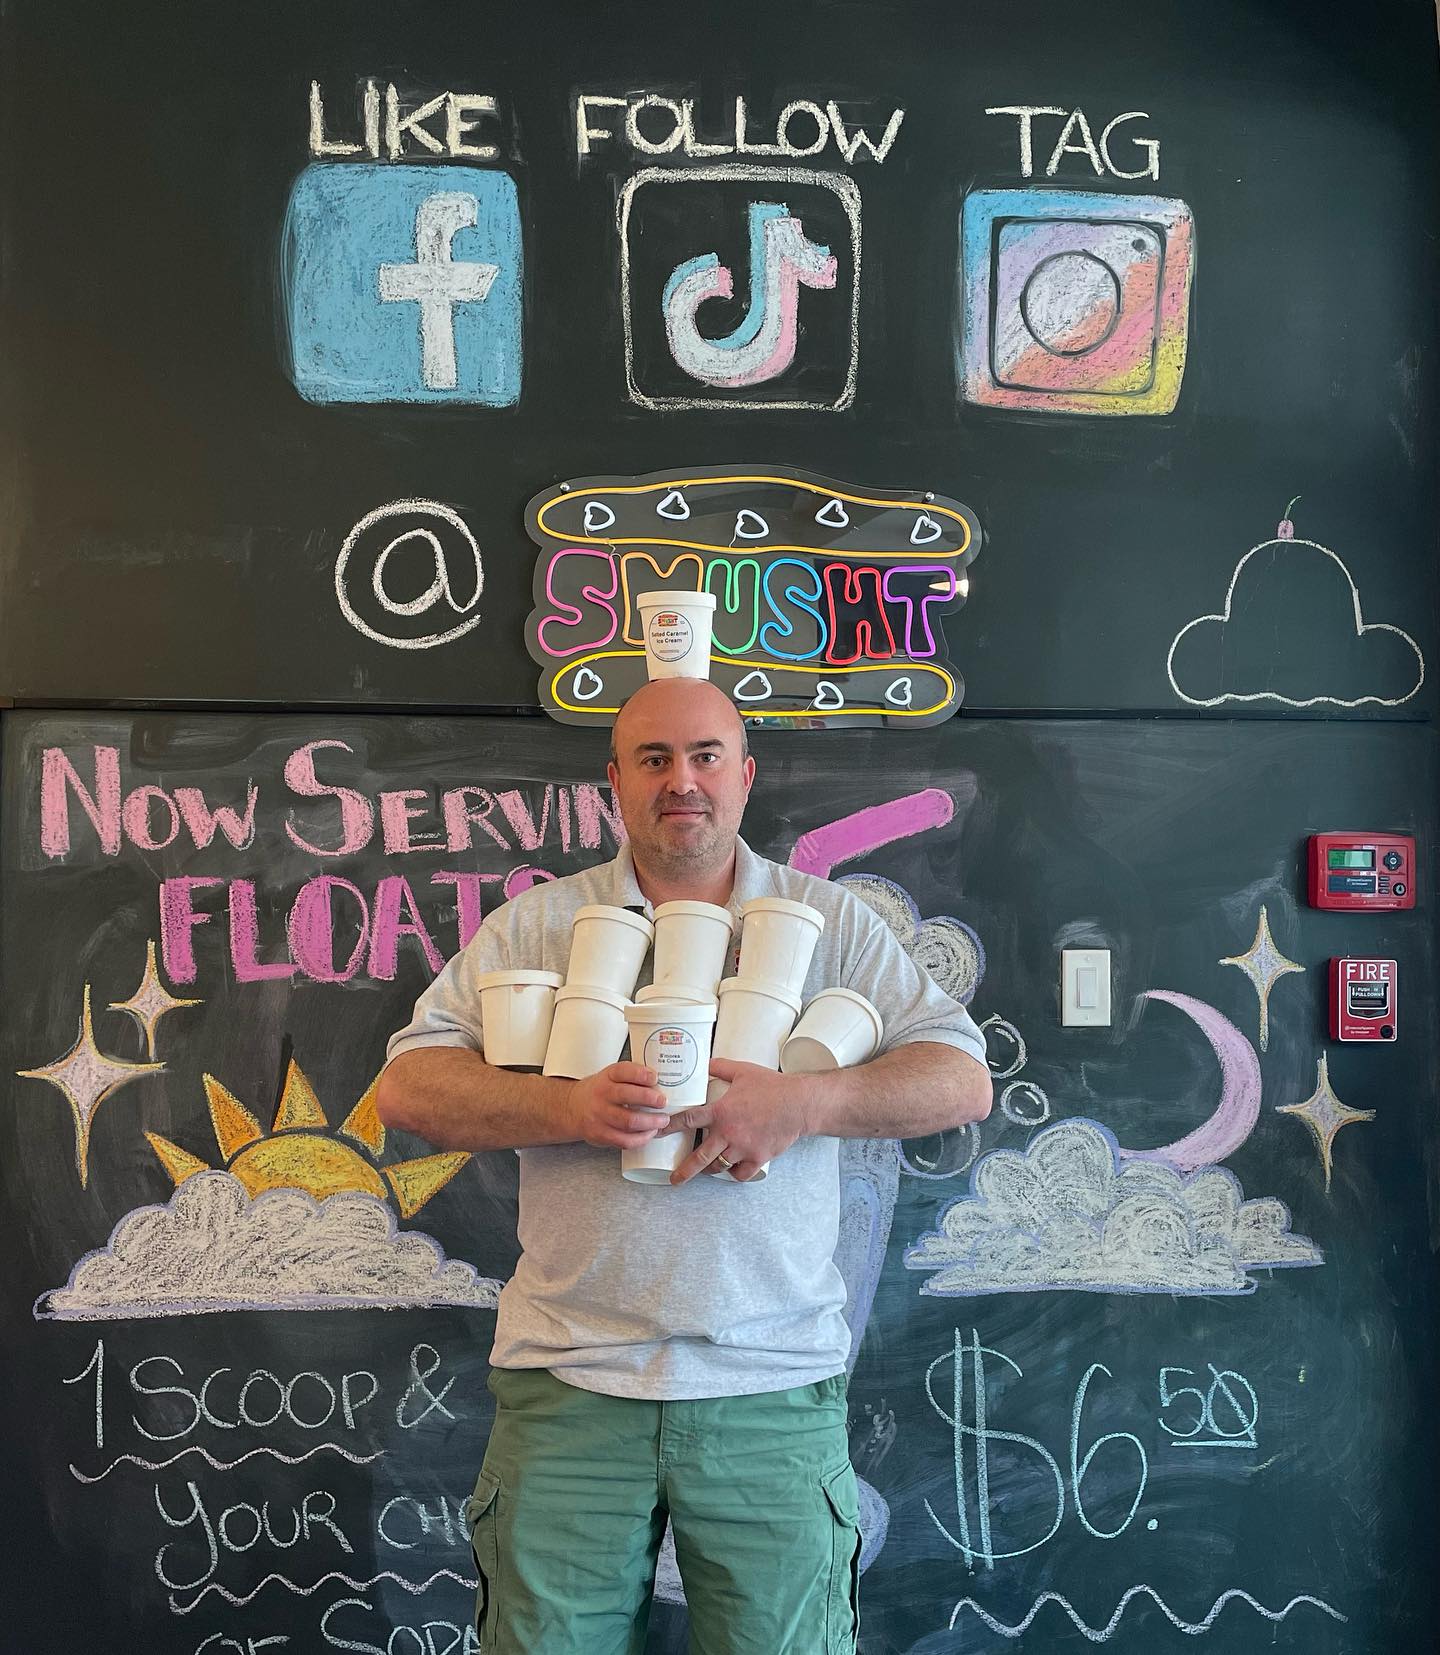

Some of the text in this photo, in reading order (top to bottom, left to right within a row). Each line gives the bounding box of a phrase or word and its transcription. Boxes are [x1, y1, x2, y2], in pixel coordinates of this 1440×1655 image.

[309, 80, 498, 159] LIKE
[577, 93, 904, 164] FOLLOW
[985, 105, 1161, 182] TAG
[334, 497, 484, 649] @
[537, 548, 956, 665] SMUSHT
[40, 739, 629, 857] NOW SERVIN
[1346, 963, 1390, 980] FIRE
[62, 1338, 457, 1449] 1 SCOOP &
[153, 1480, 354, 1590] YOUR
